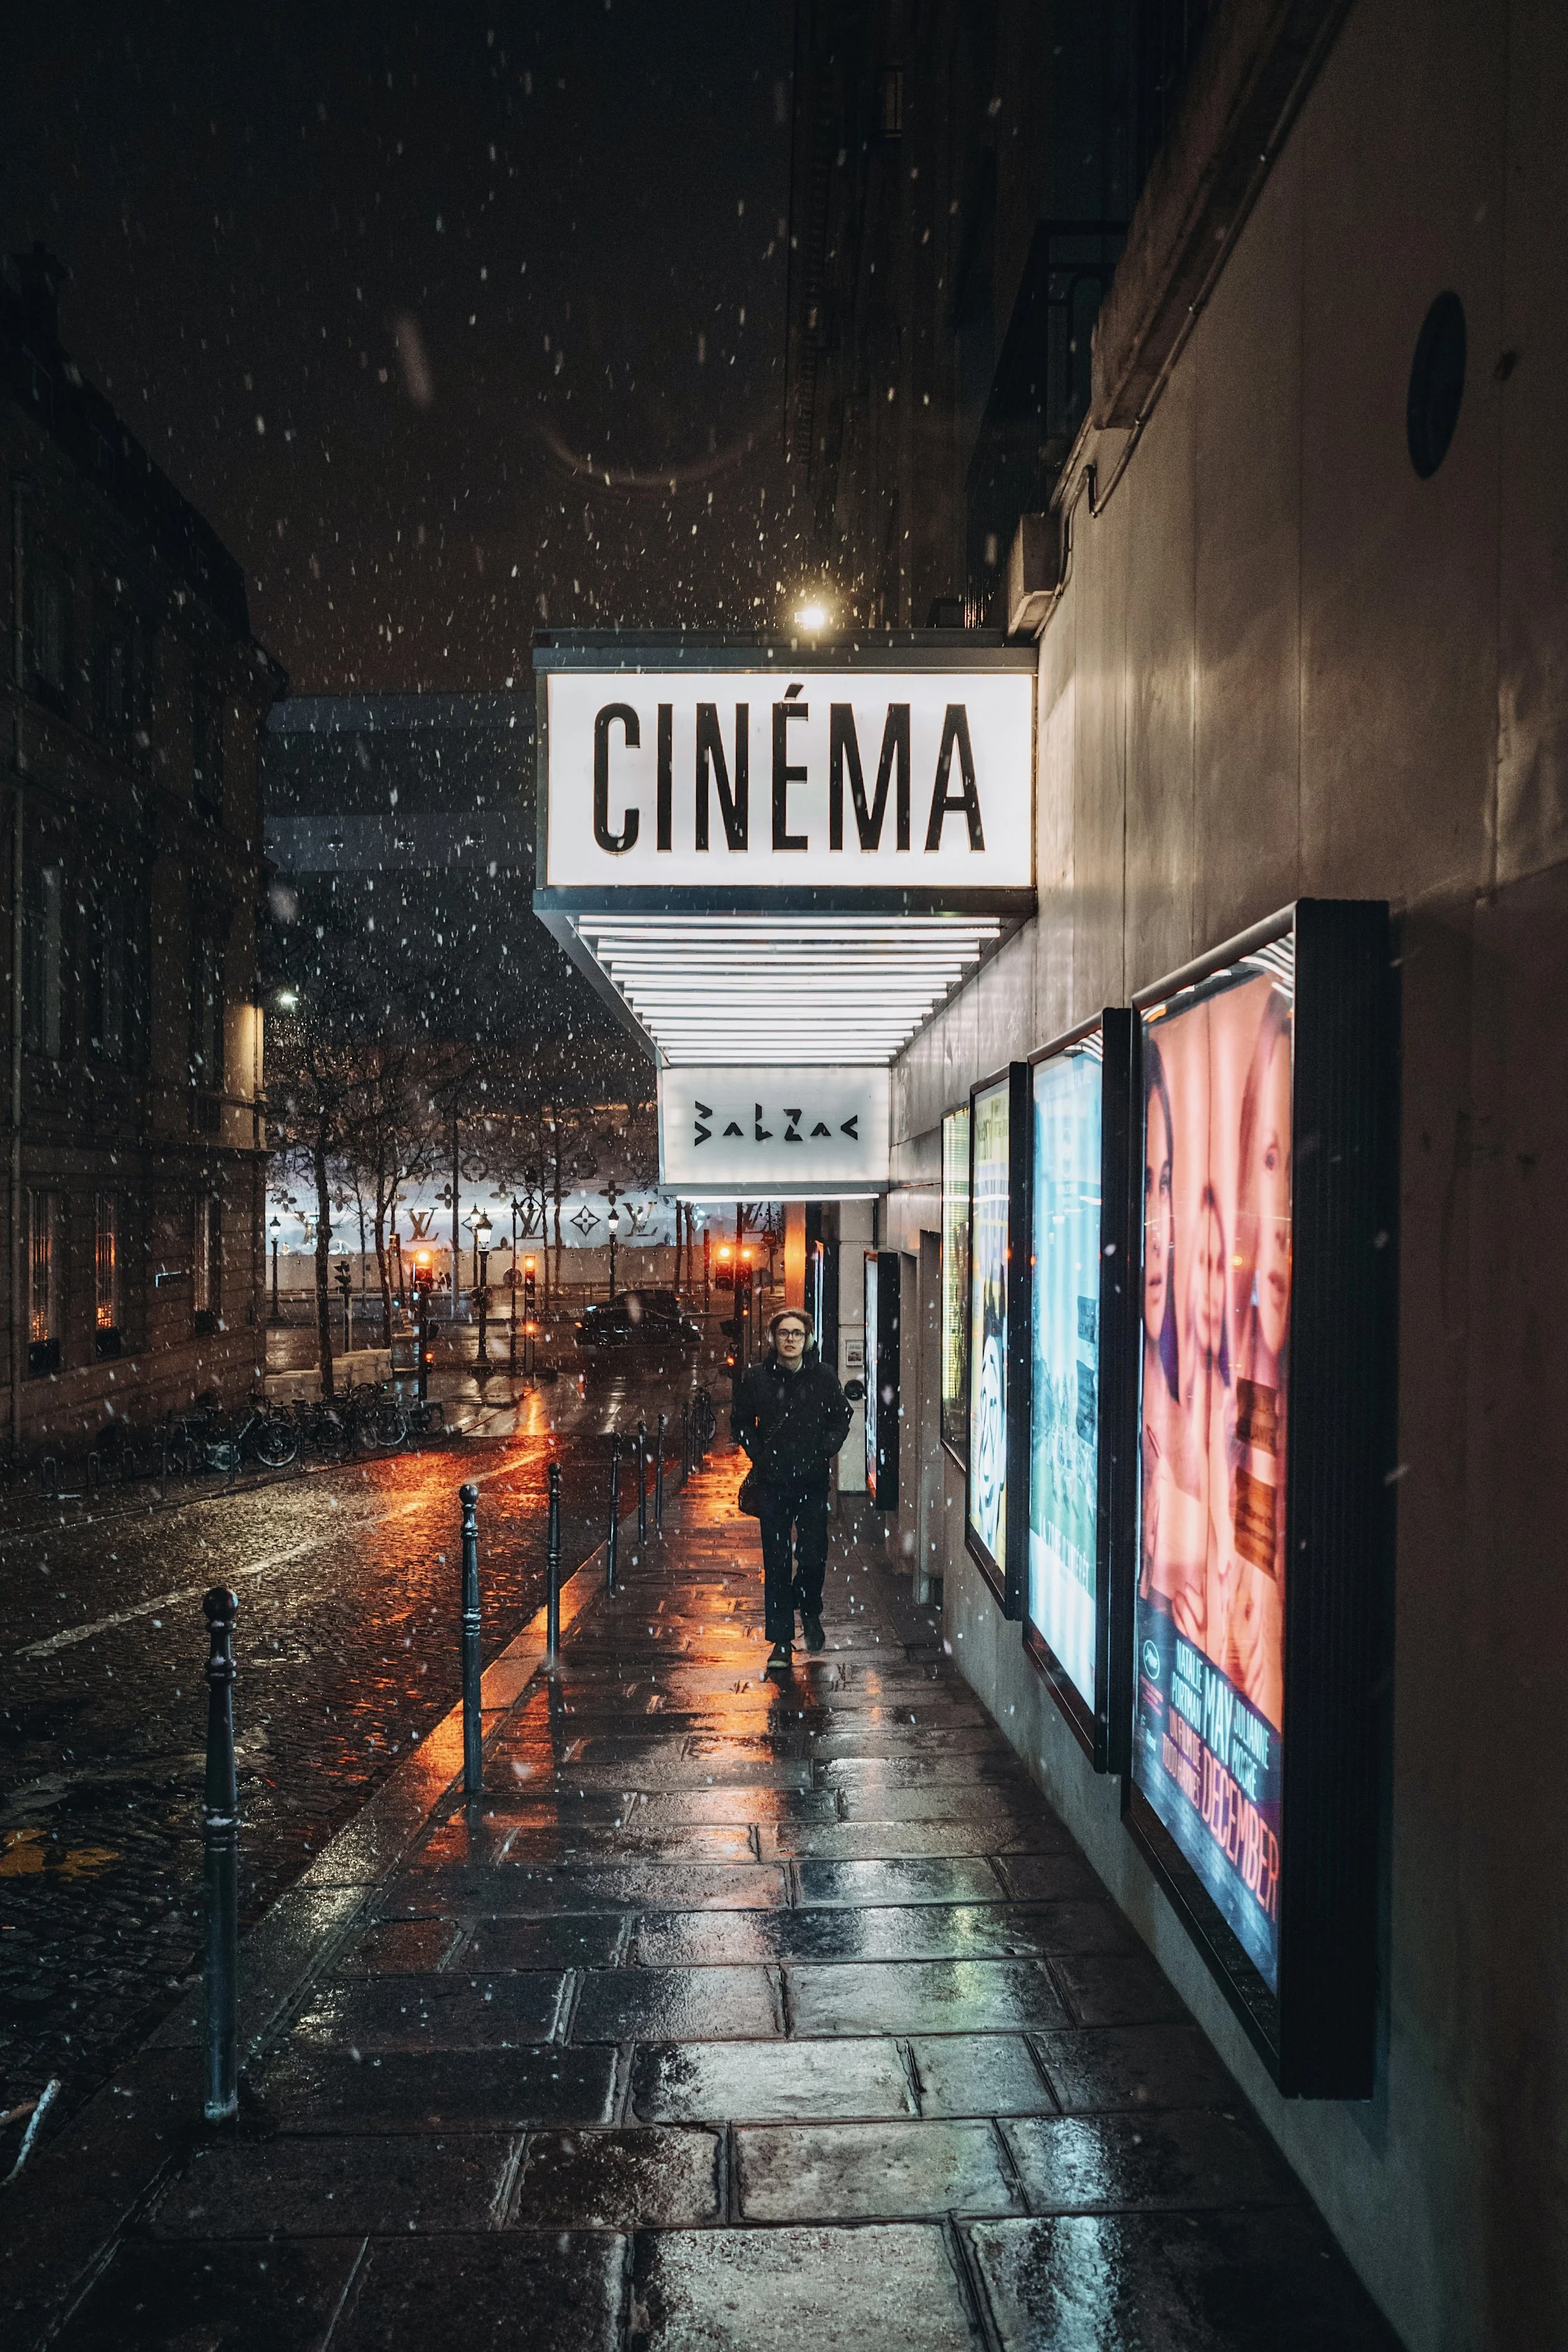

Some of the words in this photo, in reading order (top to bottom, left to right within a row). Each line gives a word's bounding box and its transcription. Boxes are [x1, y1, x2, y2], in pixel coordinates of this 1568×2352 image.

[593, 683, 986, 856] CINÉMA
[1172, 1670, 1202, 1733] PORTMAN
[1176, 1639, 1204, 1694] NATALIE
[1202, 1666, 1234, 1766] MAY
[1234, 1699, 1271, 1771] JULIANNE
[1231, 1738, 1258, 1803] MOORE
[1201, 1746, 1280, 1924] DECEMBER
